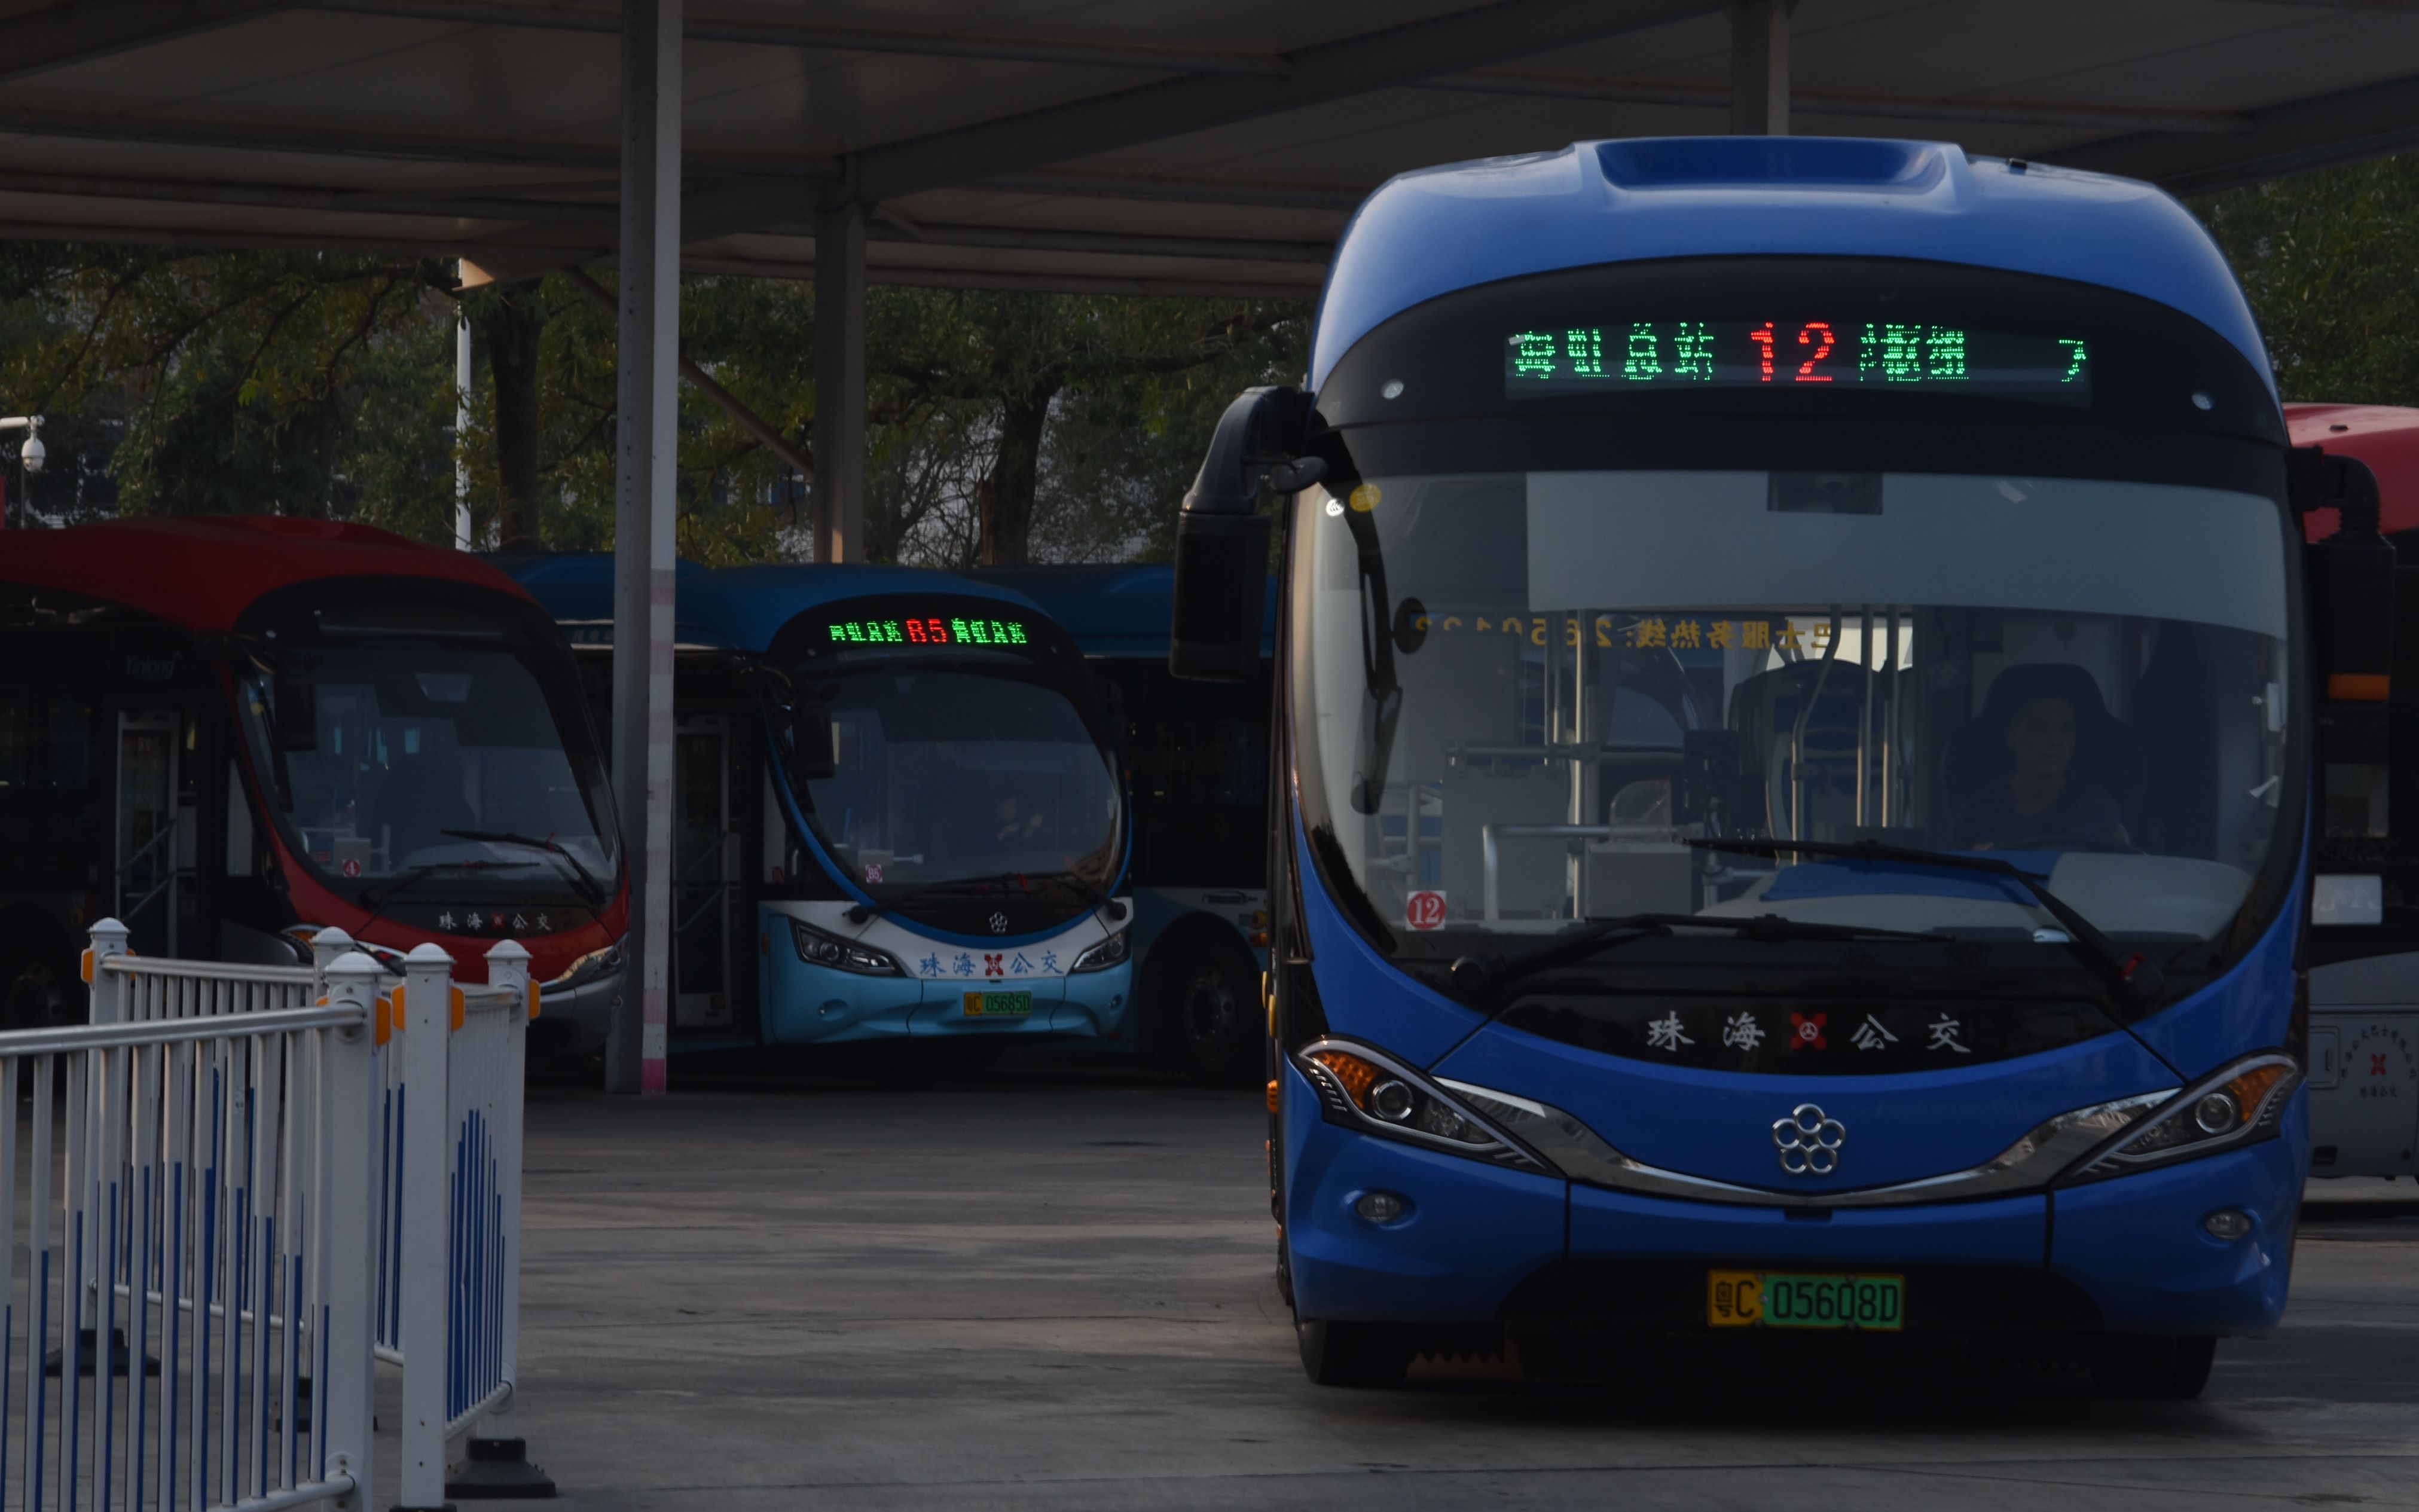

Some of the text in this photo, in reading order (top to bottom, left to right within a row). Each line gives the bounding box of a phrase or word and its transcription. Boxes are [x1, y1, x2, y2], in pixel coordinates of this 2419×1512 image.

[1751, 322, 1834, 381] 12
[438, 911, 551, 931] 珠海 公交
[1412, 897, 1440, 924] 12
[920, 950, 1064, 978] 珠海 公交
[1647, 1010, 1972, 1054] 珠海 公交
